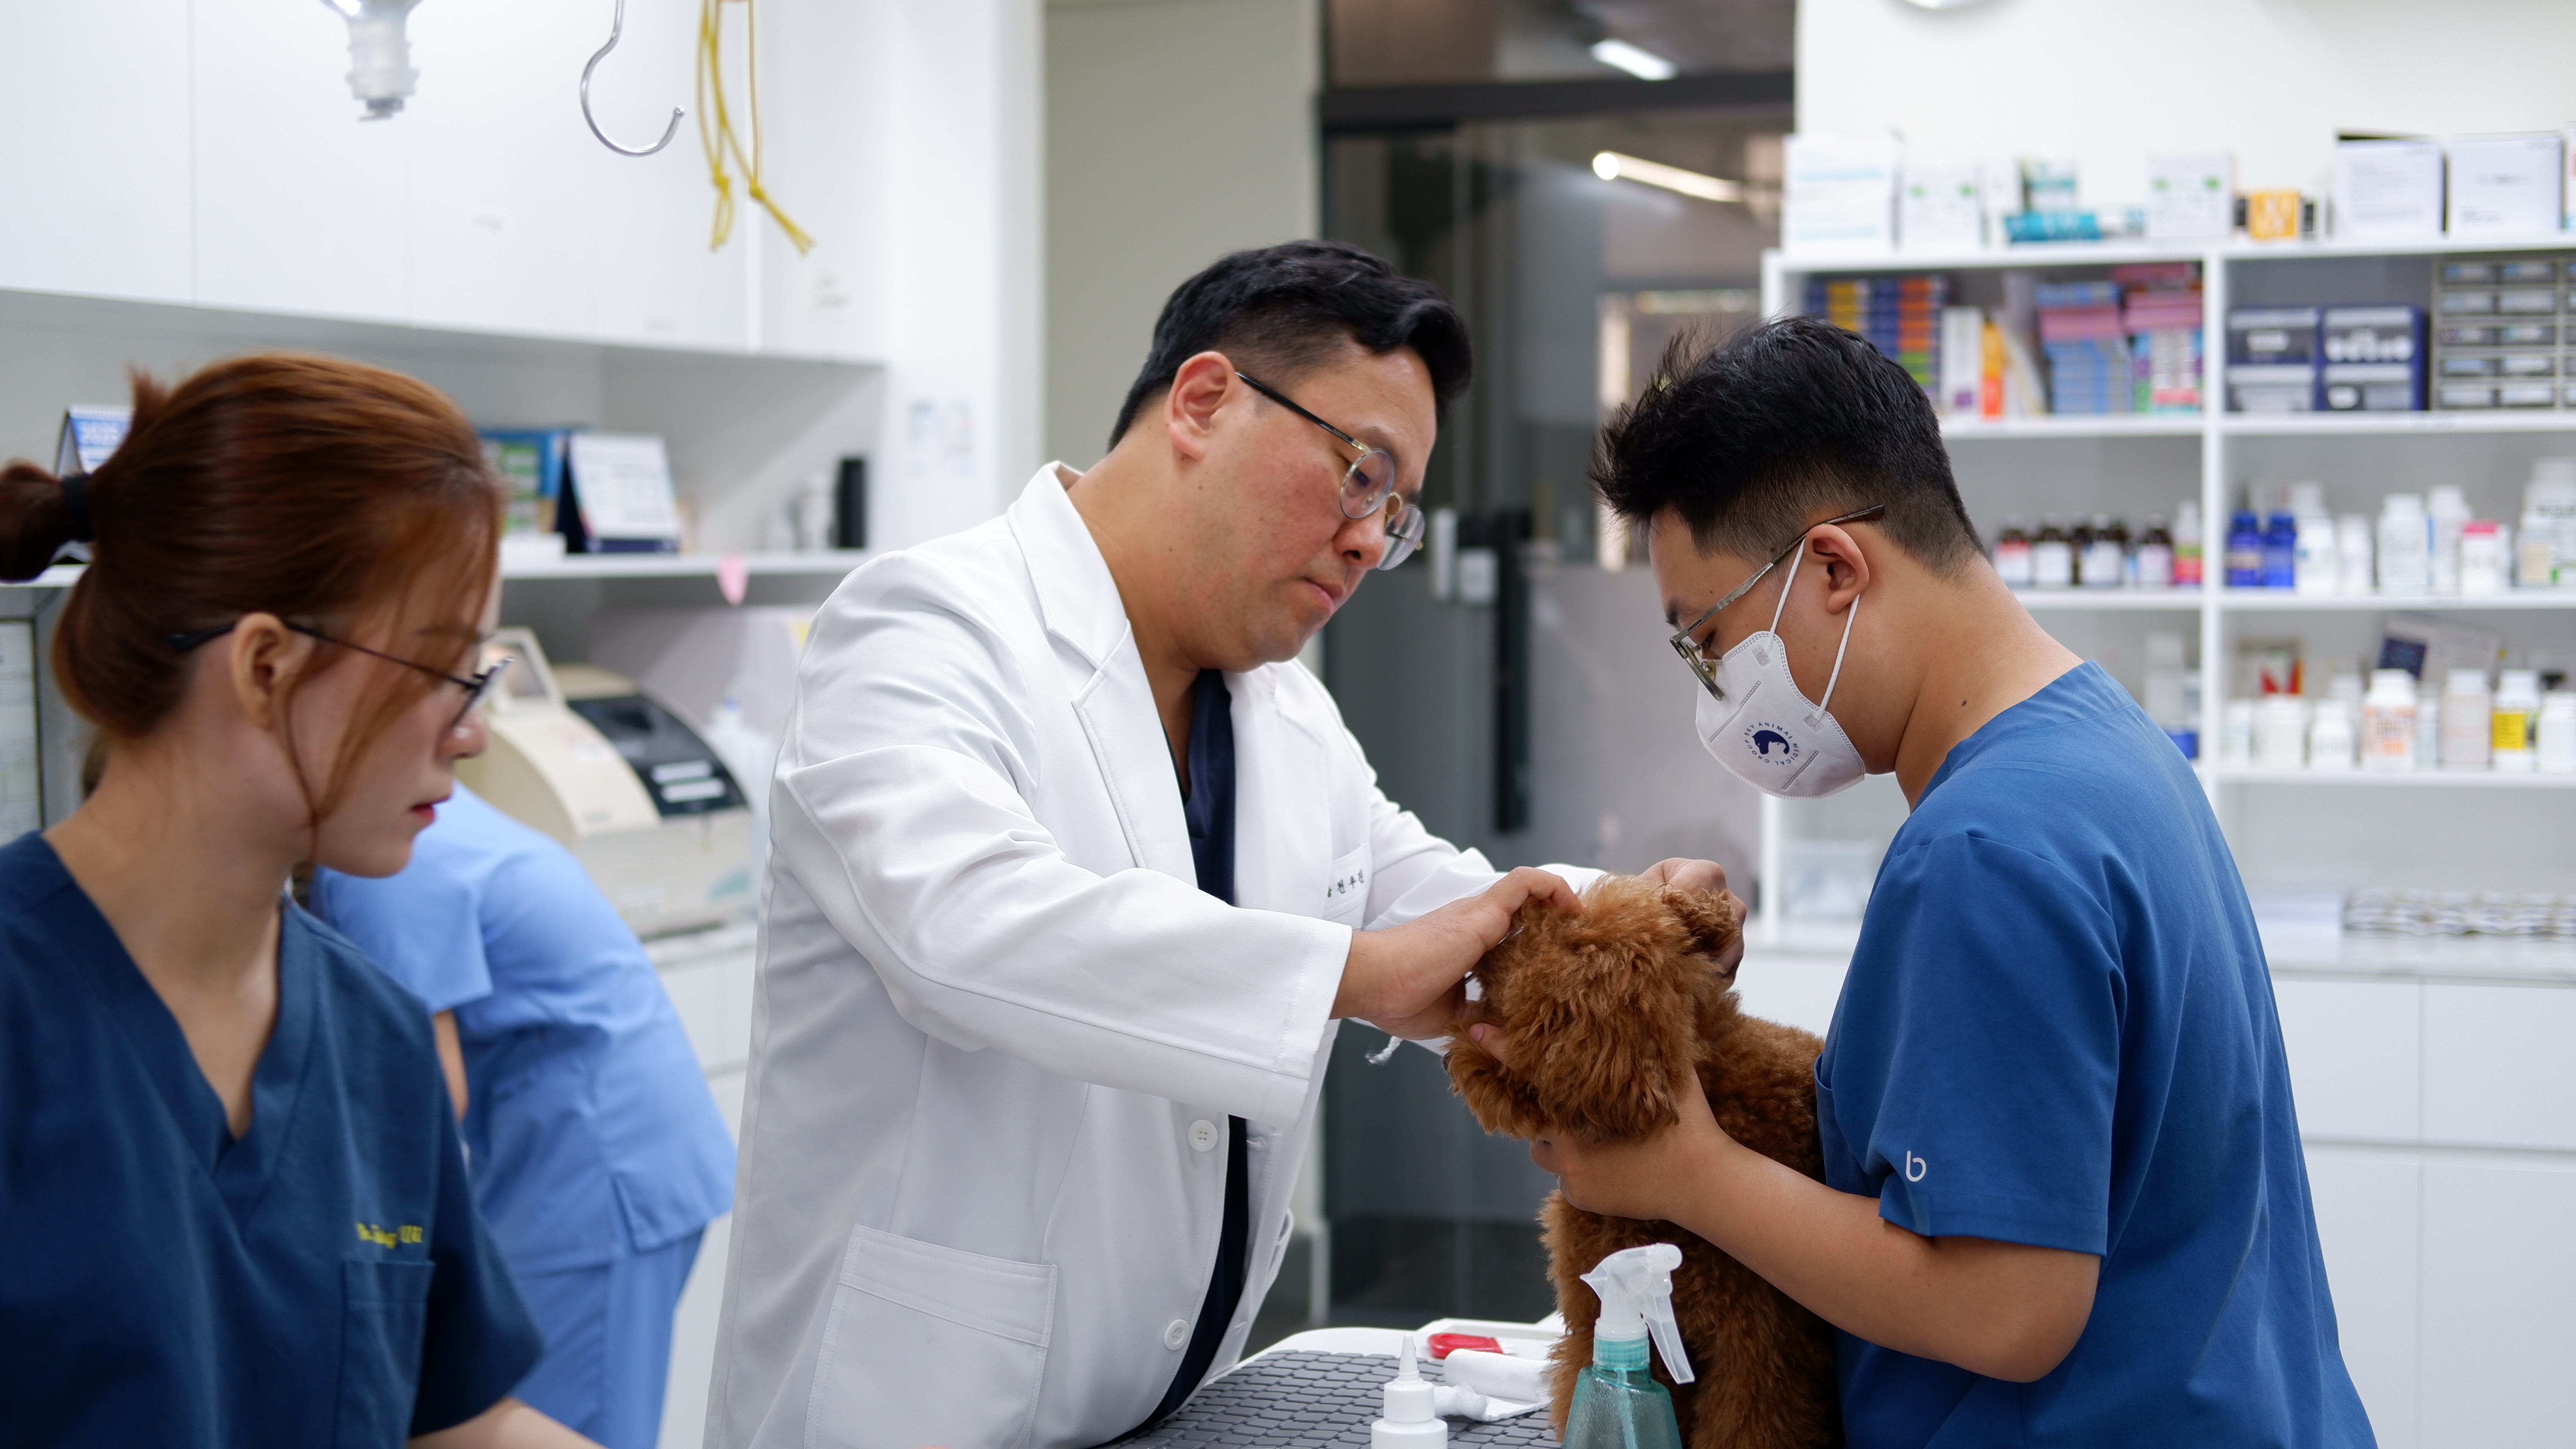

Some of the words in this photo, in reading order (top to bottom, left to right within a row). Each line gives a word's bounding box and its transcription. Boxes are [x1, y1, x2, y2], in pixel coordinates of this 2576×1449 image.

[1744, 724, 1755, 737] SKY
[1759, 722, 1793, 740] ANIMAL
[1745, 740, 1769, 763] GROUP
[1775, 743, 1799, 766] MEDICAL
